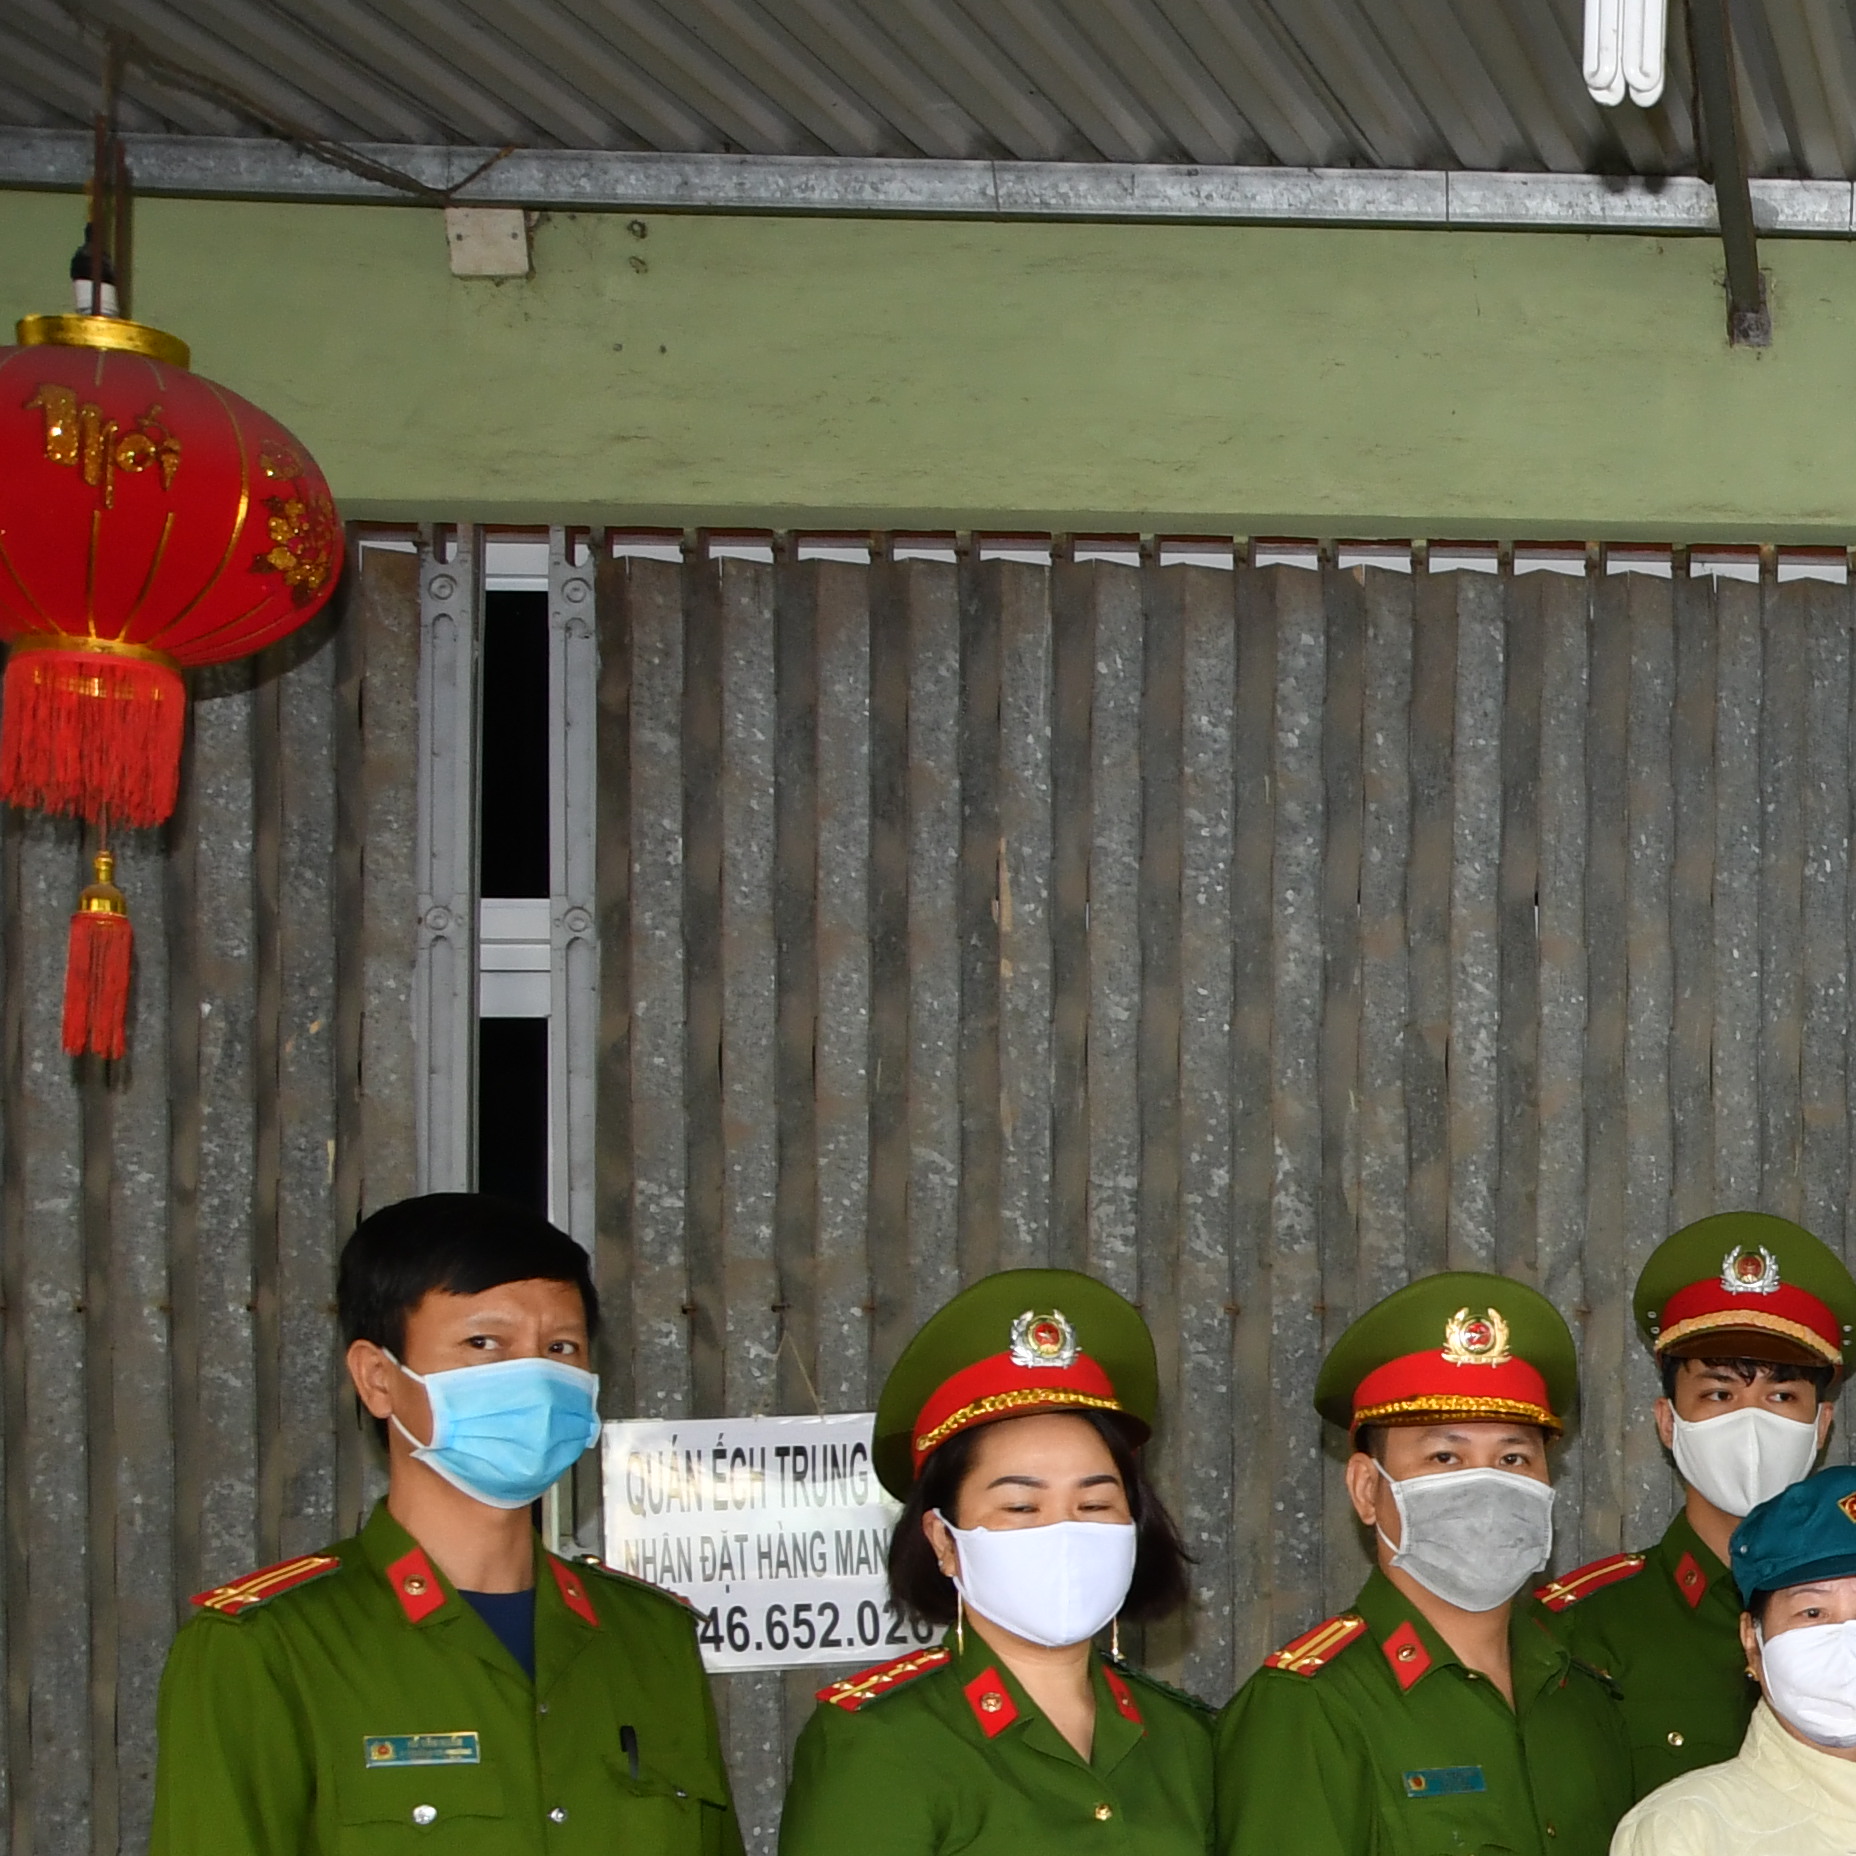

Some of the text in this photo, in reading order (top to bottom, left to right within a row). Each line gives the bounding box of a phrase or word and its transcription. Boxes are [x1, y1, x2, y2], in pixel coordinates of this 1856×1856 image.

[626, 1432, 869, 1518] QUÁN ẾCH TRUNG
[700, 1530, 749, 1594] ĐẶT
[757, 1521, 828, 1580] HÀNG
[700, 1600, 935, 1652] 46.652.02
